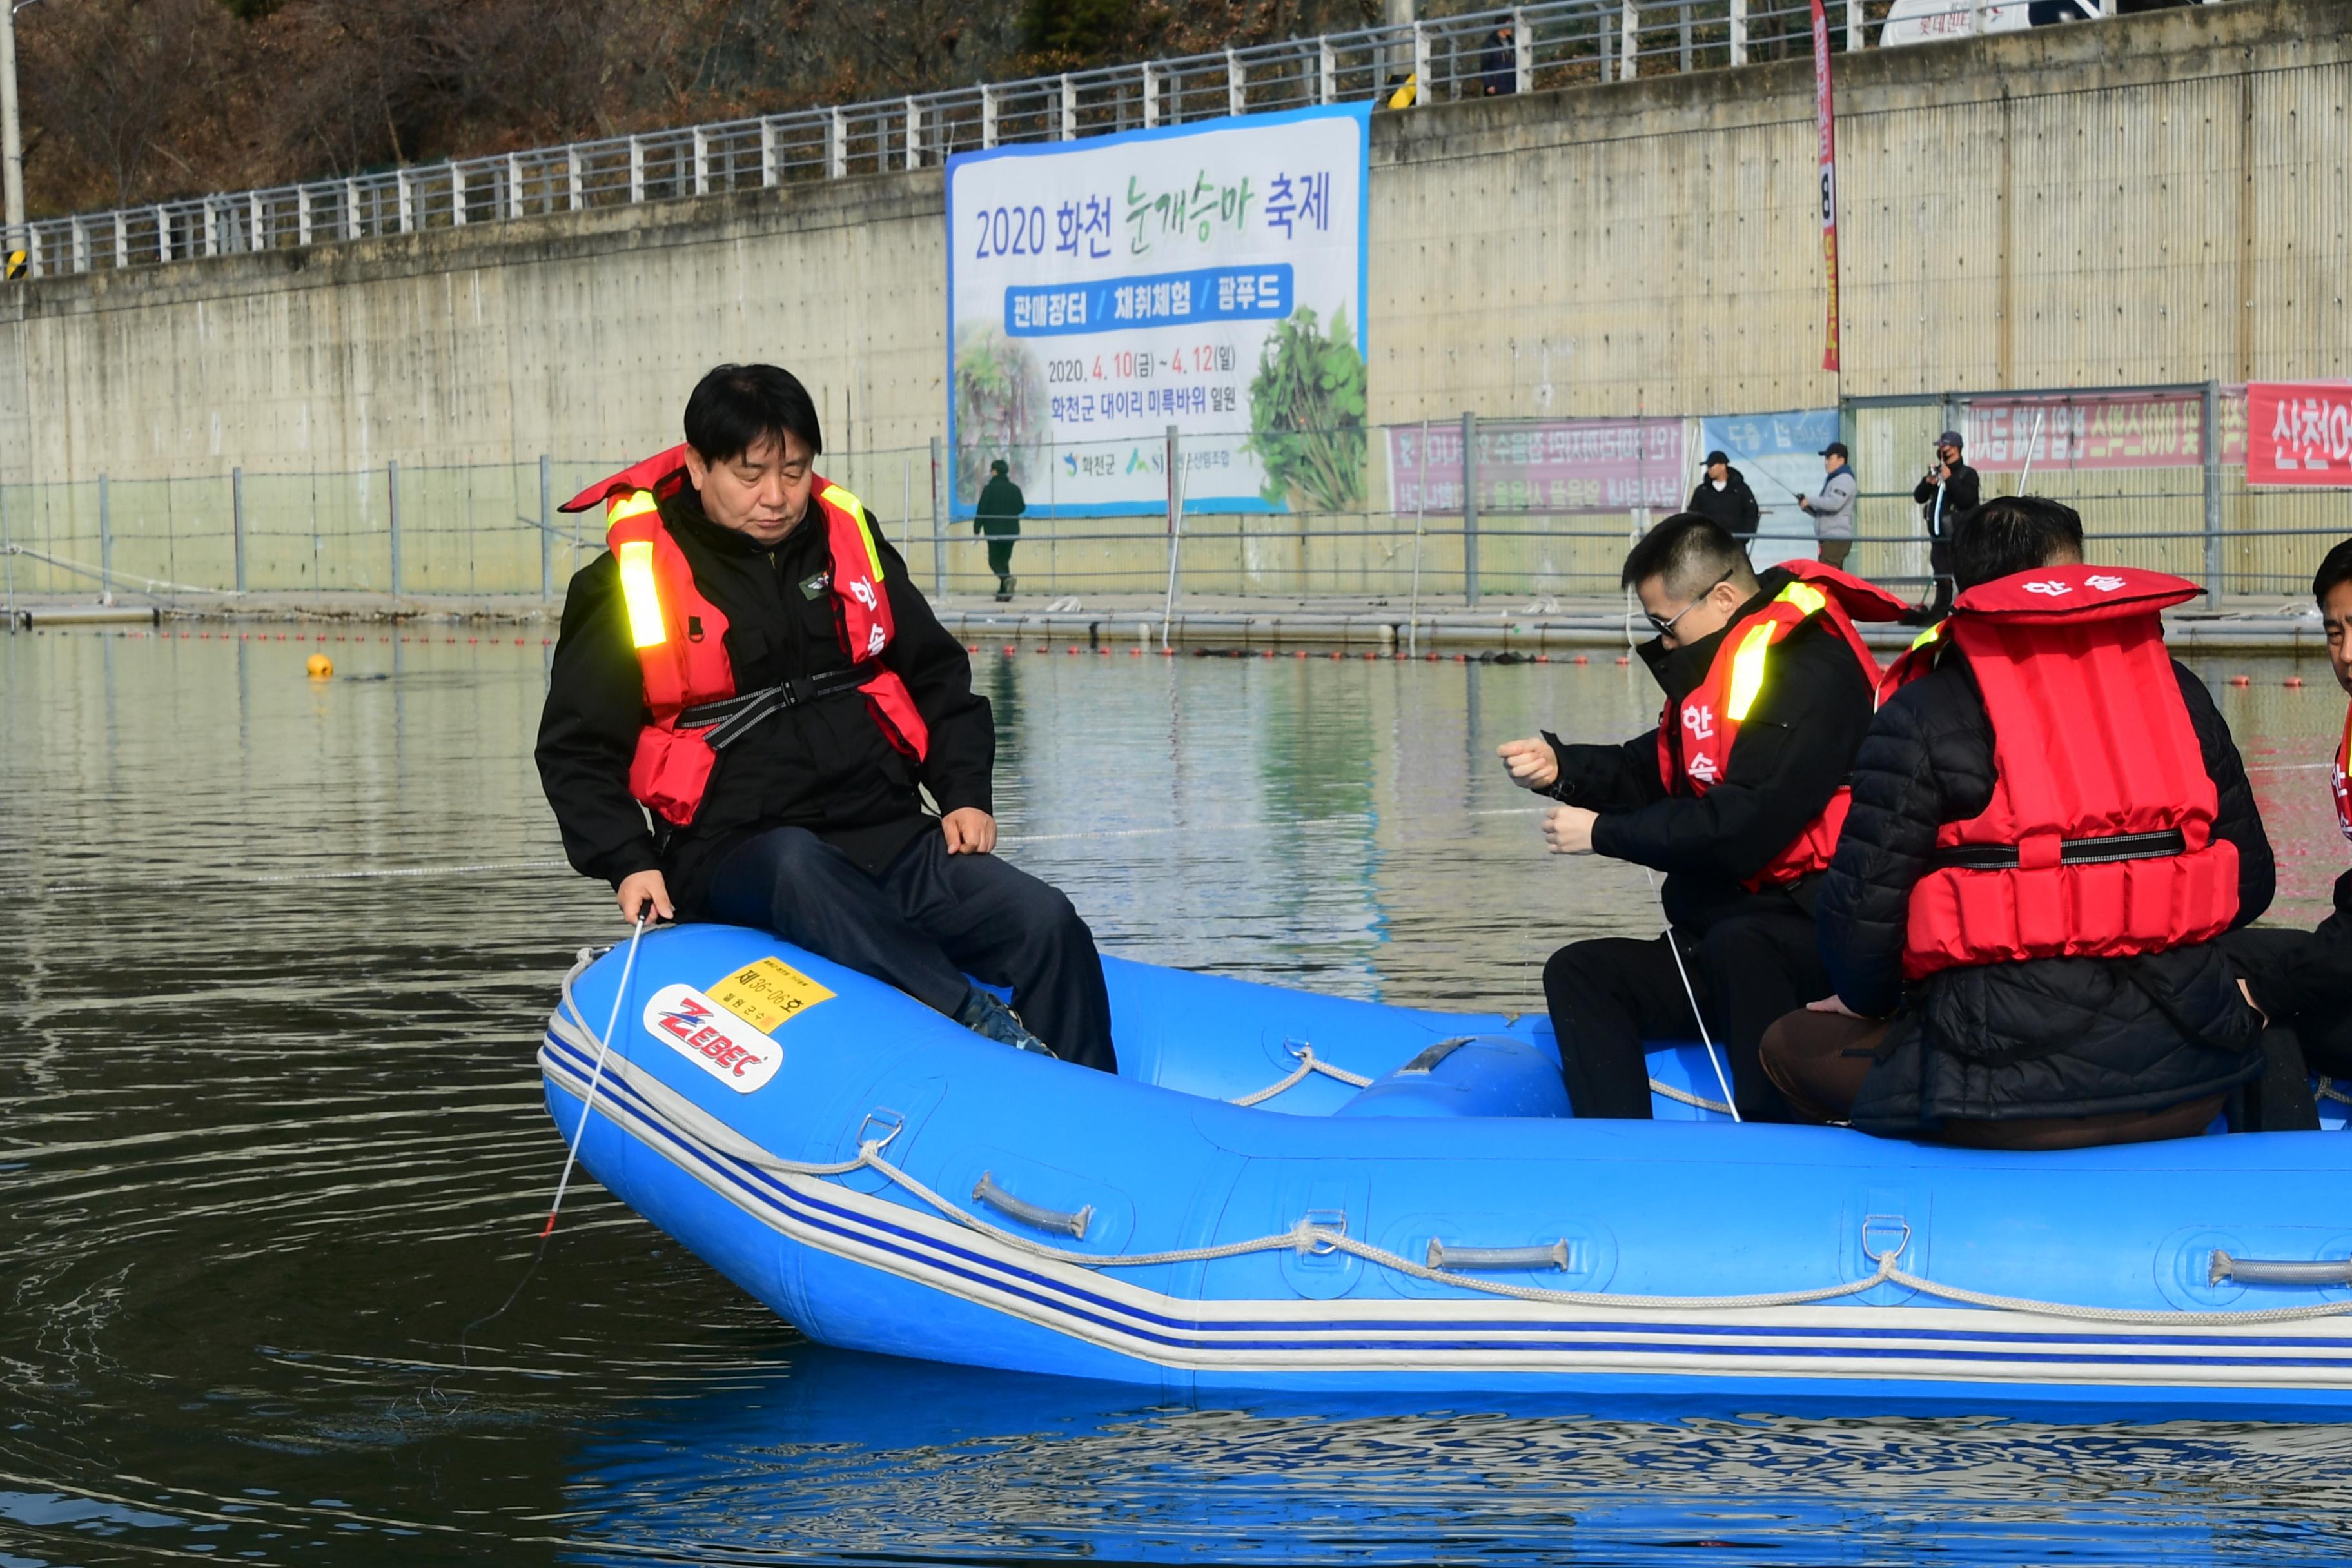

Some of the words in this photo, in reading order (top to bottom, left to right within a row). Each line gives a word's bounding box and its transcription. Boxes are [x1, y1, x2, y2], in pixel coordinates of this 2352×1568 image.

[976, 206, 1046, 259] 2020
[1056, 195, 1111, 259] 화천
[1126, 170, 1255, 255] 눈개승마
[1265, 172, 1329, 240] 축제
[1014, 291, 1087, 328] 판매장터
[1114, 280, 1191, 319] 채취체험
[1218, 275, 1280, 311] 팜푸드
[1052, 395, 1095, 423] 화천군
[1101, 391, 1143, 419] 대이리
[1148, 386, 1206, 418] 미륵바위
[1211, 386, 1237, 413] 일원
[1083, 453, 1115, 476] 화천군
[658, 997, 763, 1077] ZEBEC
